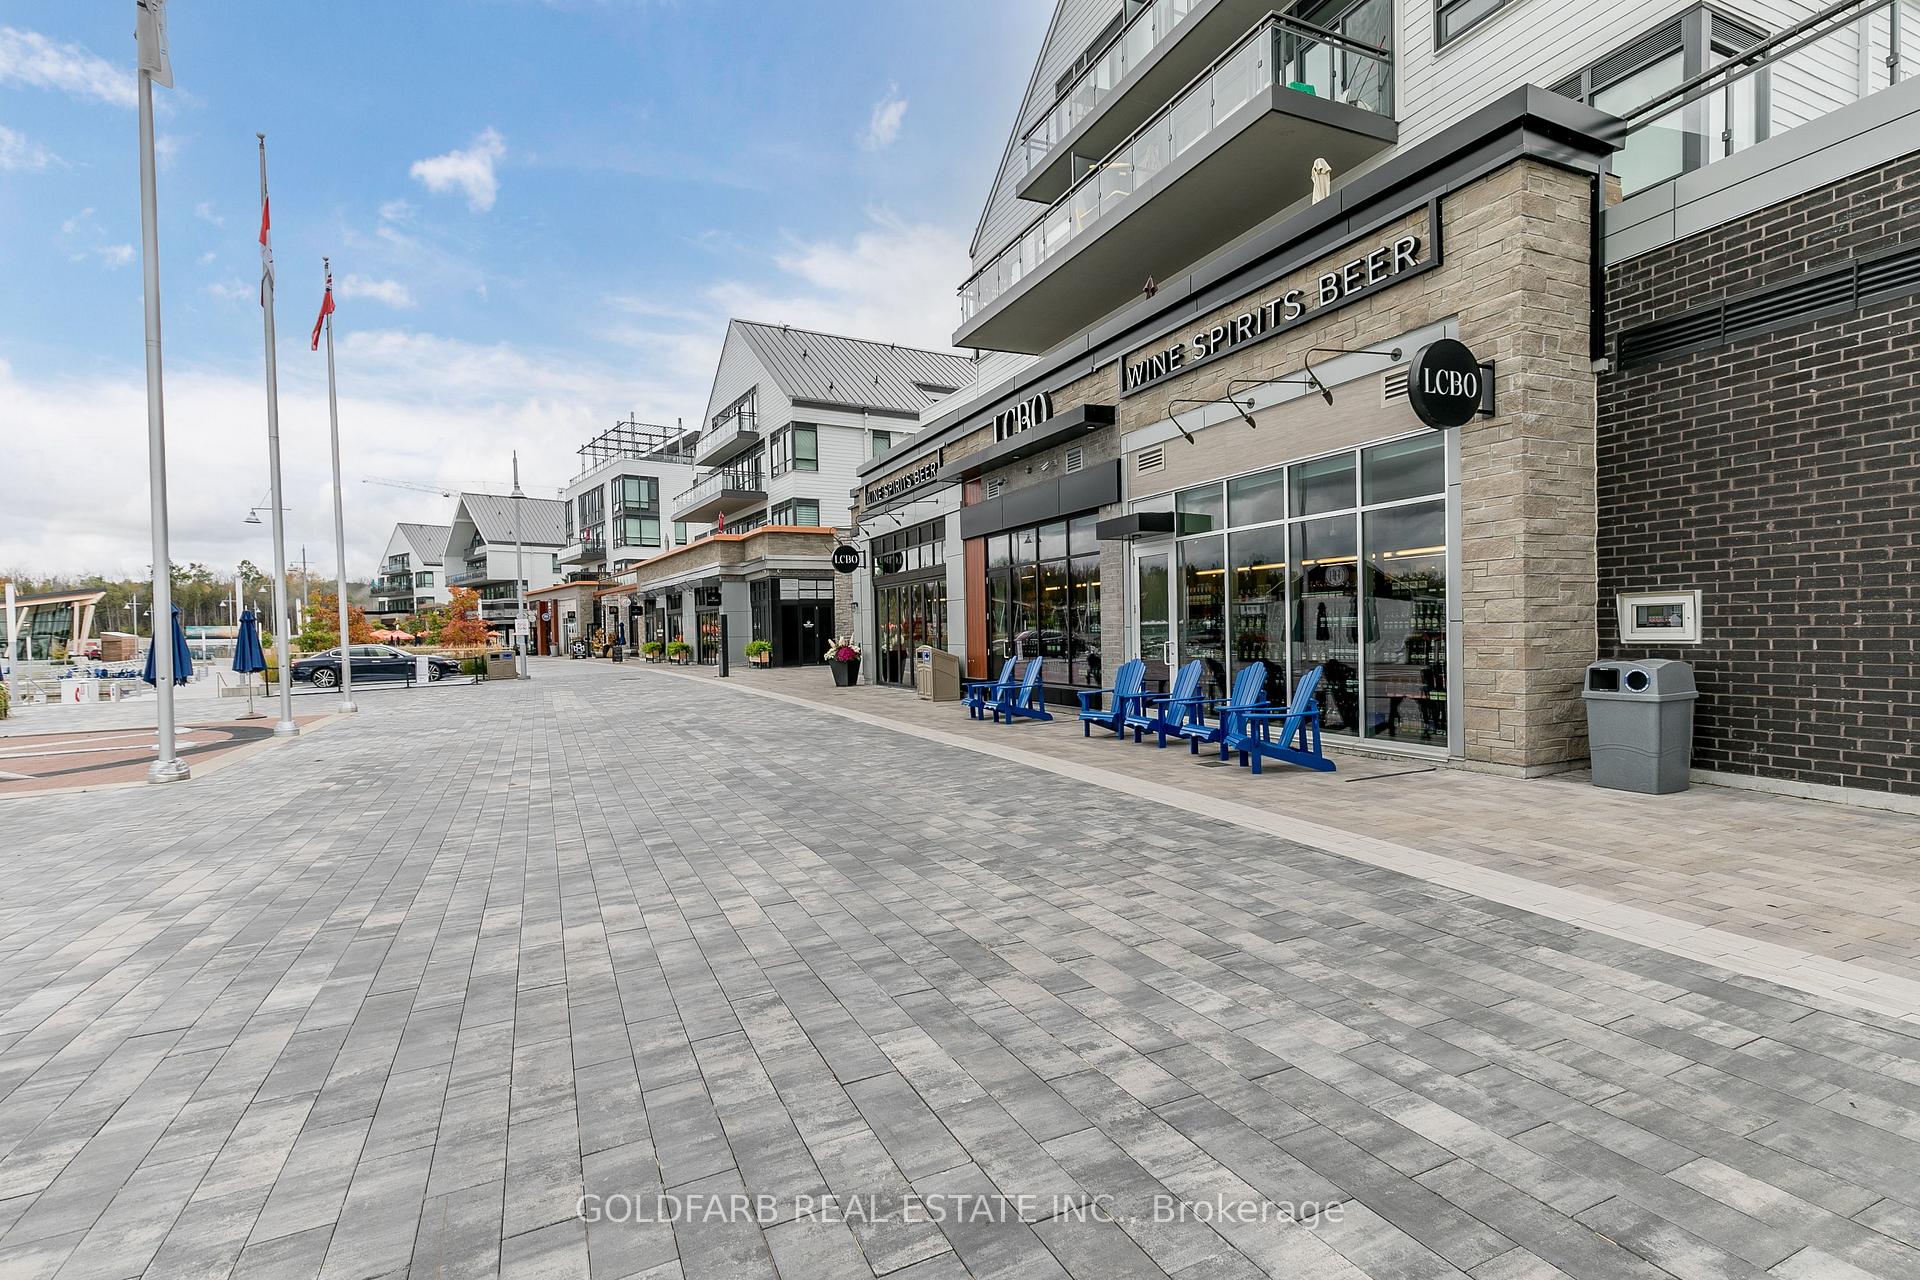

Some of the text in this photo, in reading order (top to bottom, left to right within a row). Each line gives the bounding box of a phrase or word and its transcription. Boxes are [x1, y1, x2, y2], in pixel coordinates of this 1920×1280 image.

[1127, 235, 1421, 389] WINE SPIRITS BEER
[1424, 367, 1477, 398] LCBO
[884, 473, 912, 498] SPIRITS
[914, 462, 937, 485] BEER
[834, 554, 858, 564] LCBO
